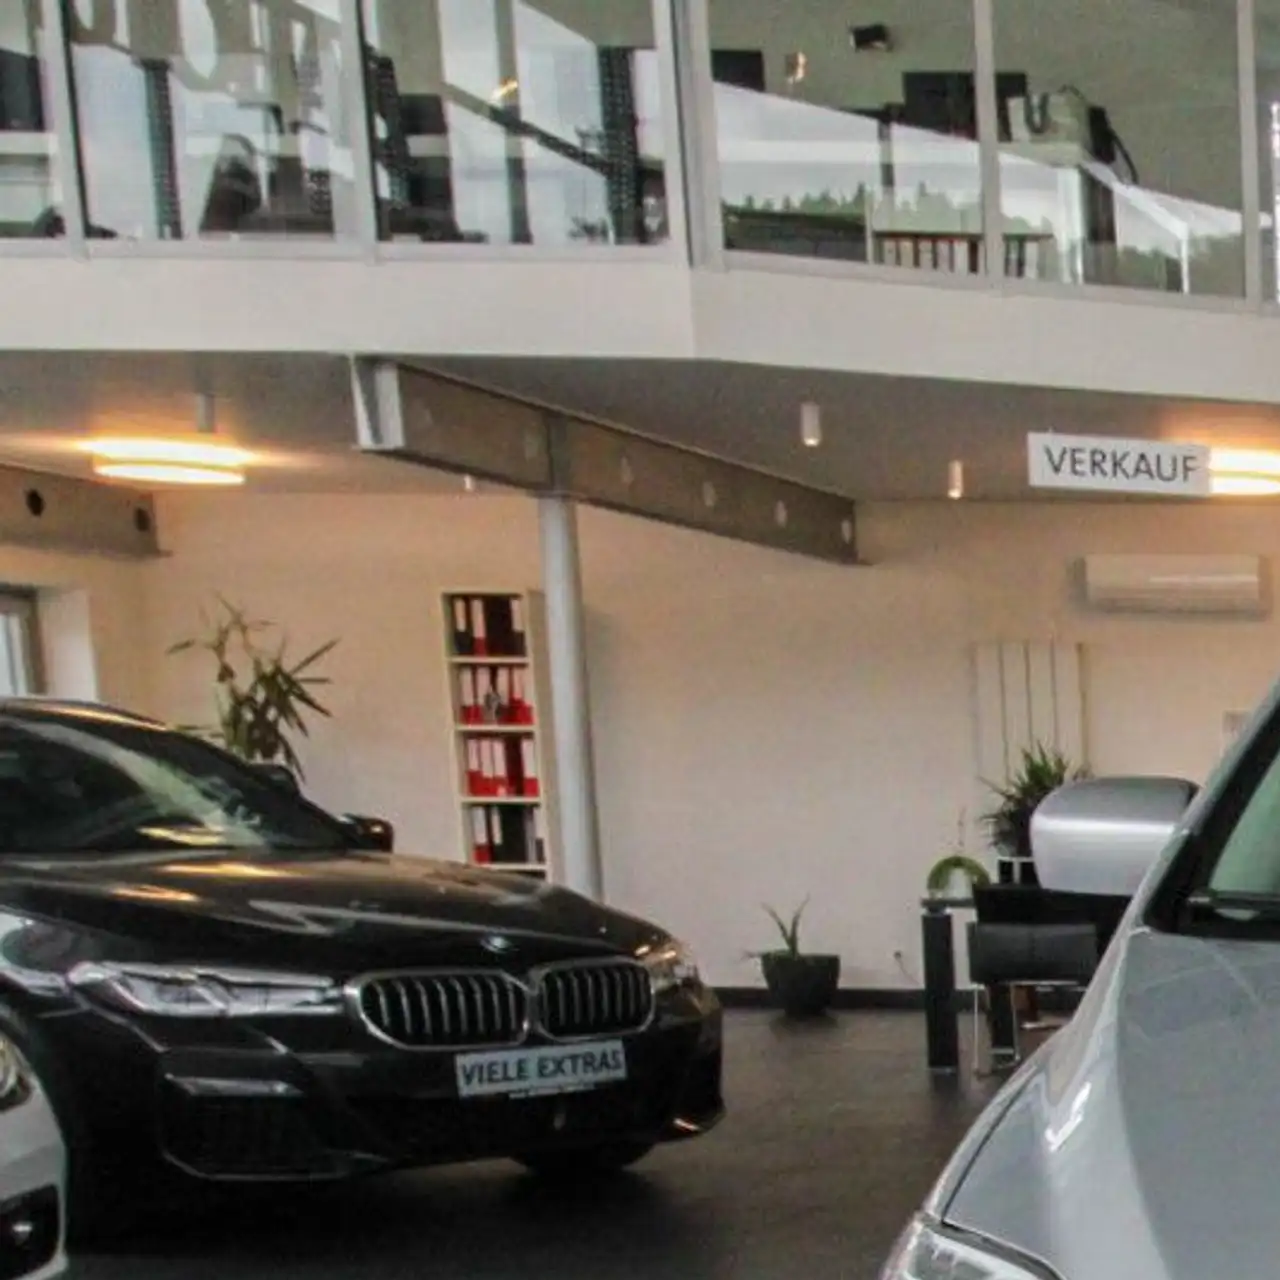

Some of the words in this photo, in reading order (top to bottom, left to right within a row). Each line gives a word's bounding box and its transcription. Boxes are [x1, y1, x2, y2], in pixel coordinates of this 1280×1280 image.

[1045, 445, 1200, 483] VERKAUF
[462, 1058, 531, 1086] VIELE
[536, 1048, 624, 1078] EXTRAS
